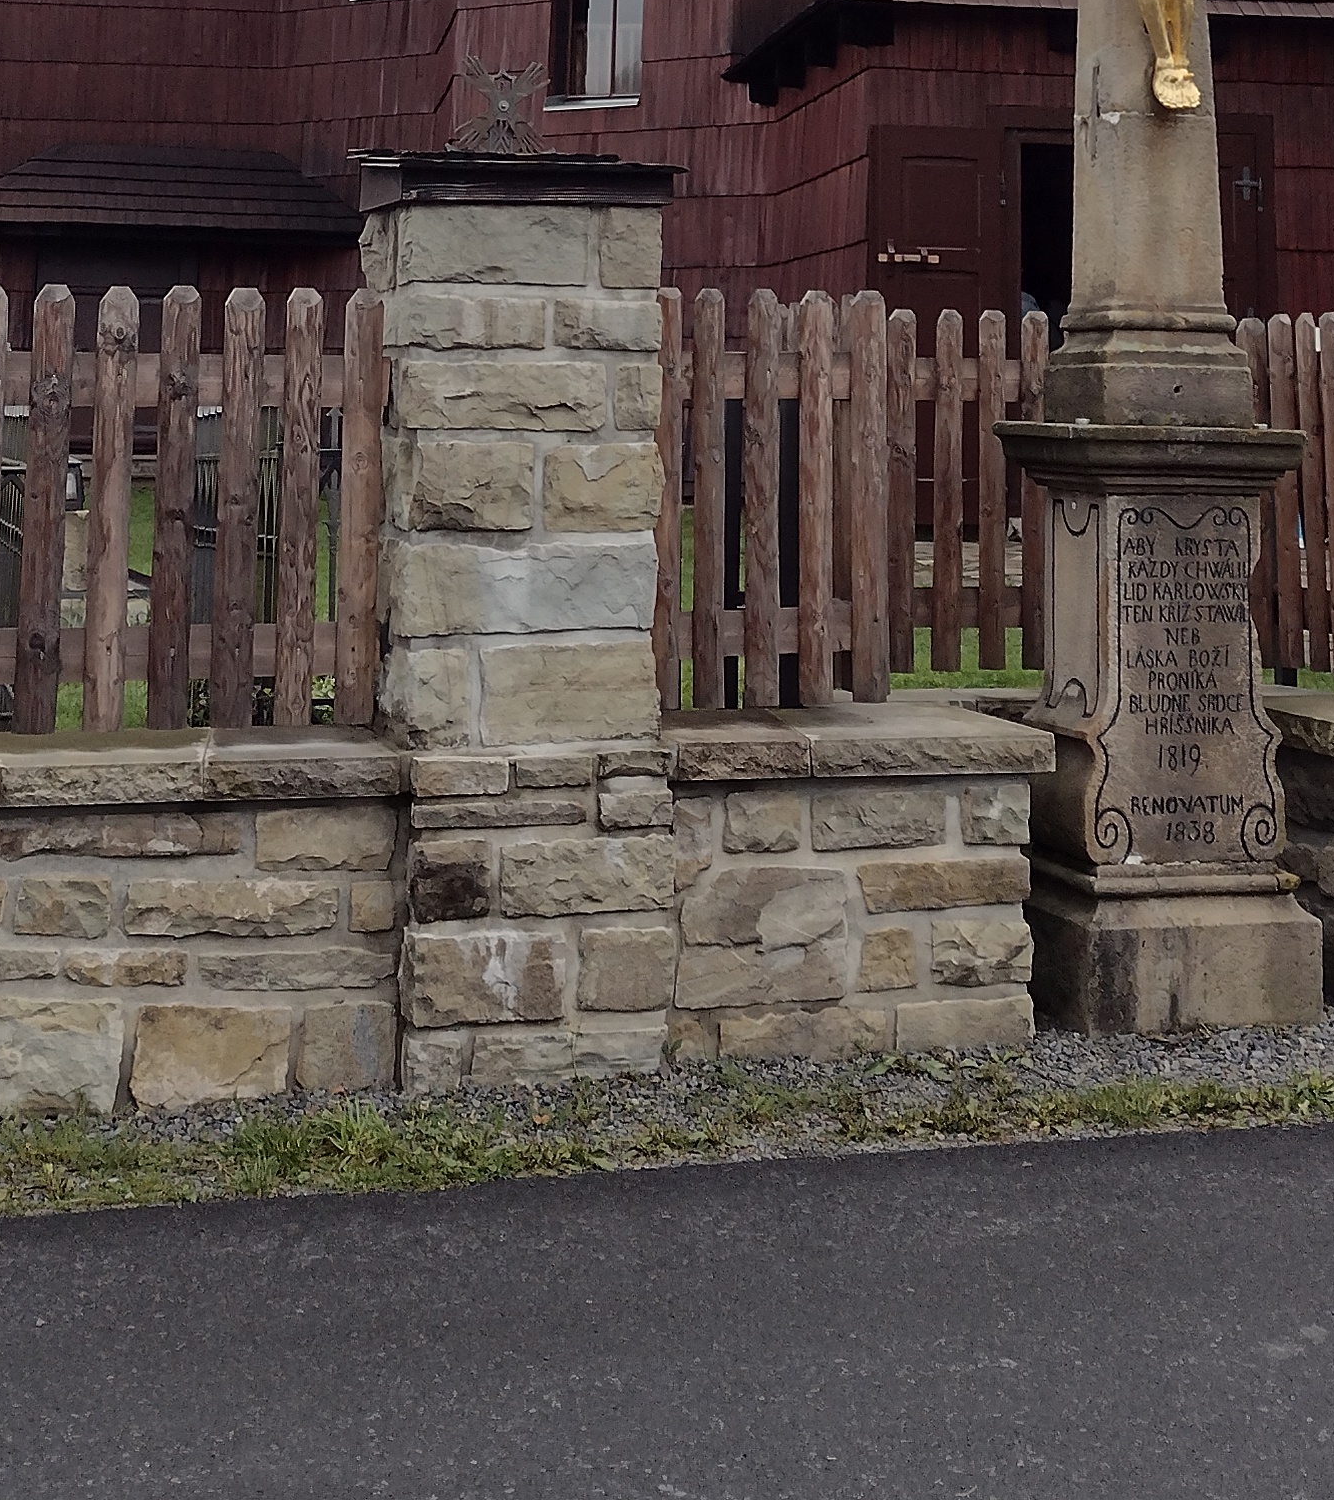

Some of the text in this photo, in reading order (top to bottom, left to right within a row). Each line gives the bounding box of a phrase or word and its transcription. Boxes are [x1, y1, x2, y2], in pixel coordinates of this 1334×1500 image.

[1123, 536, 1240, 557] ABY KRYSTA
[1123, 582, 1147, 601] LID
[1122, 604, 1153, 623] TEN
[1164, 627, 1200, 646] NEB
[1126, 644, 1229, 669] LÁSKA BOŽÍ
[1198, 693, 1244, 713] SRDCE
[1130, 794, 1245, 816] RENOVATUM
